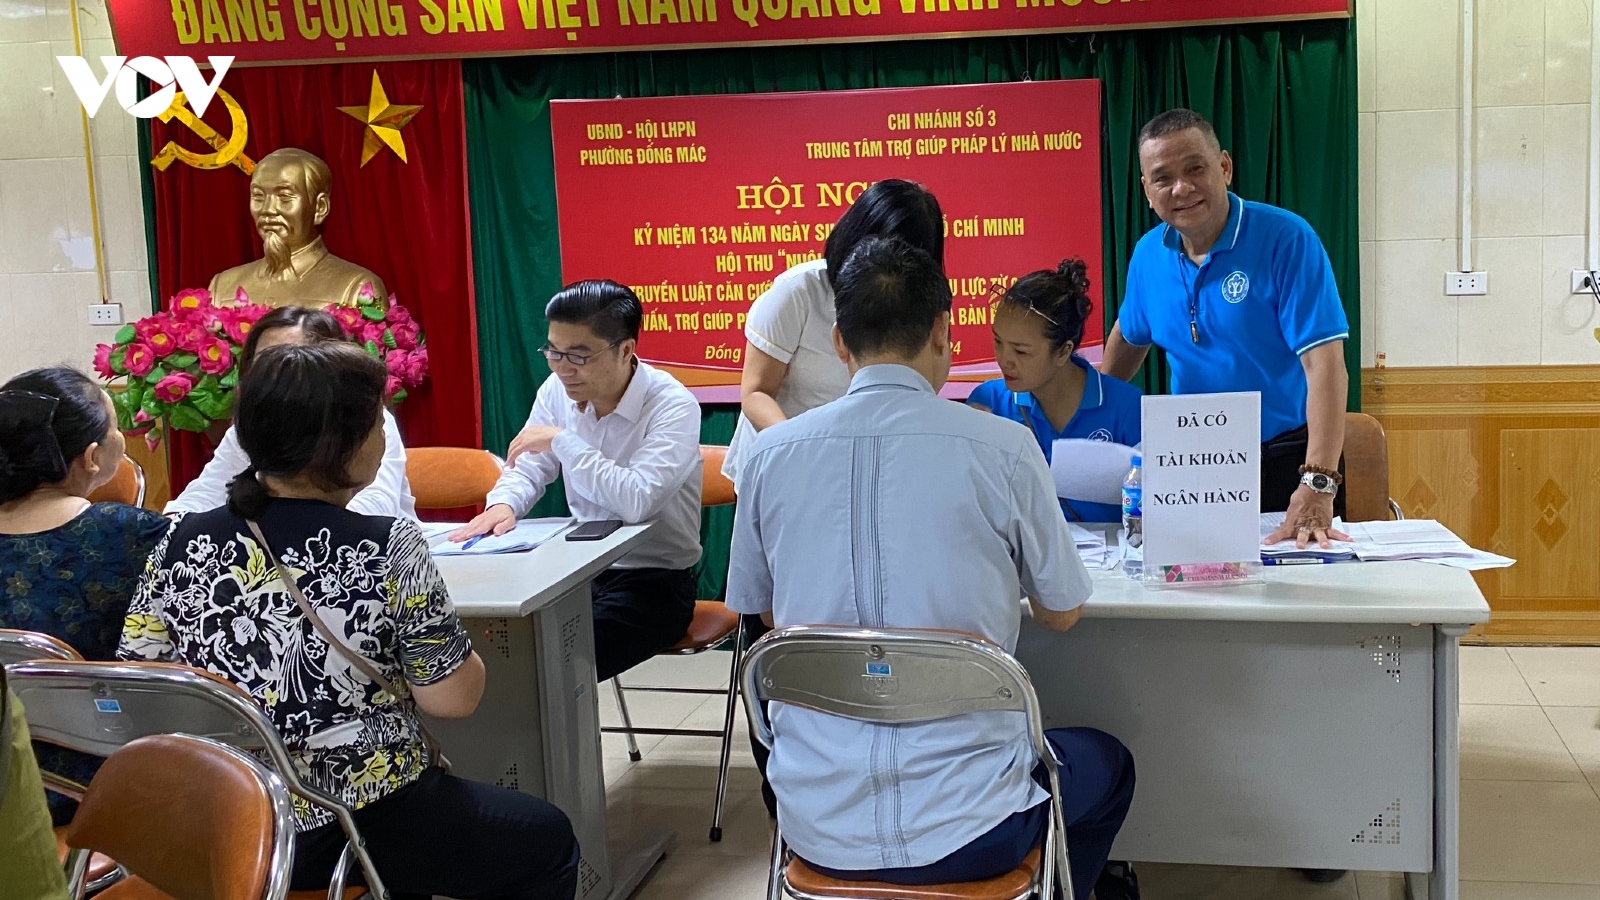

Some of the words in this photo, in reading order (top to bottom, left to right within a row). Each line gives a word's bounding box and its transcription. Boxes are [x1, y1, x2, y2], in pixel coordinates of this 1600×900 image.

[587, 123, 624, 141] UBND
[635, 119, 658, 142] HỘI
[661, 120, 697, 139] LHPN
[887, 113, 910, 131] CHI
[914, 109, 962, 130] NHÁNH
[965, 105, 985, 128] SỐ
[988, 110, 997, 128] 3
[580, 145, 634, 166] PHƯỜNG
[636, 142, 673, 165] ĐỐNG
[676, 145, 707, 164] MÁC
[806, 141, 850, 160] TRUNG
[853, 138, 883, 158] TÂM
[886, 138, 912, 160] TRỢ
[916, 135, 947, 156] GIÚP
[951, 134, 988, 154] PHÁP
[991, 132, 1007, 153] LÝ
[1011, 131, 1040, 152] NHÀ
[1043, 129, 1083, 151] NƯỚC
[736, 176, 805, 214] HỘI
[816, 181, 878, 207] NG
[633, 222, 653, 246] KỶ
[657, 223, 696, 249] NIỆM
[700, 226, 728, 245] 134
[731, 222, 767, 244] NĂM
[770, 220, 810, 243] NGÀY
[953, 214, 979, 238] CHÍ
[983, 217, 1025, 237] MINH
[716, 251, 742, 276] HỘI
[745, 254, 774, 272] THU
[681, 280, 713, 306] LUẬT
[716, 280, 744, 302] CĂN
[961, 276, 987, 300] LỰC
[674, 311, 700, 335] TRỢ
[703, 309, 734, 331] GIÚP
[958, 303, 988, 326] BÀN
[705, 343, 741, 363] Đống
[1177, 411, 1200, 428] ĐÃ
[1203, 410, 1228, 427] CÓ
[1156, 451, 1185, 467] TÀI
[1189, 449, 1248, 466] KHOẢN
[1153, 489, 1200, 506] NGÂN
[1204, 488, 1251, 504] HÀNG
